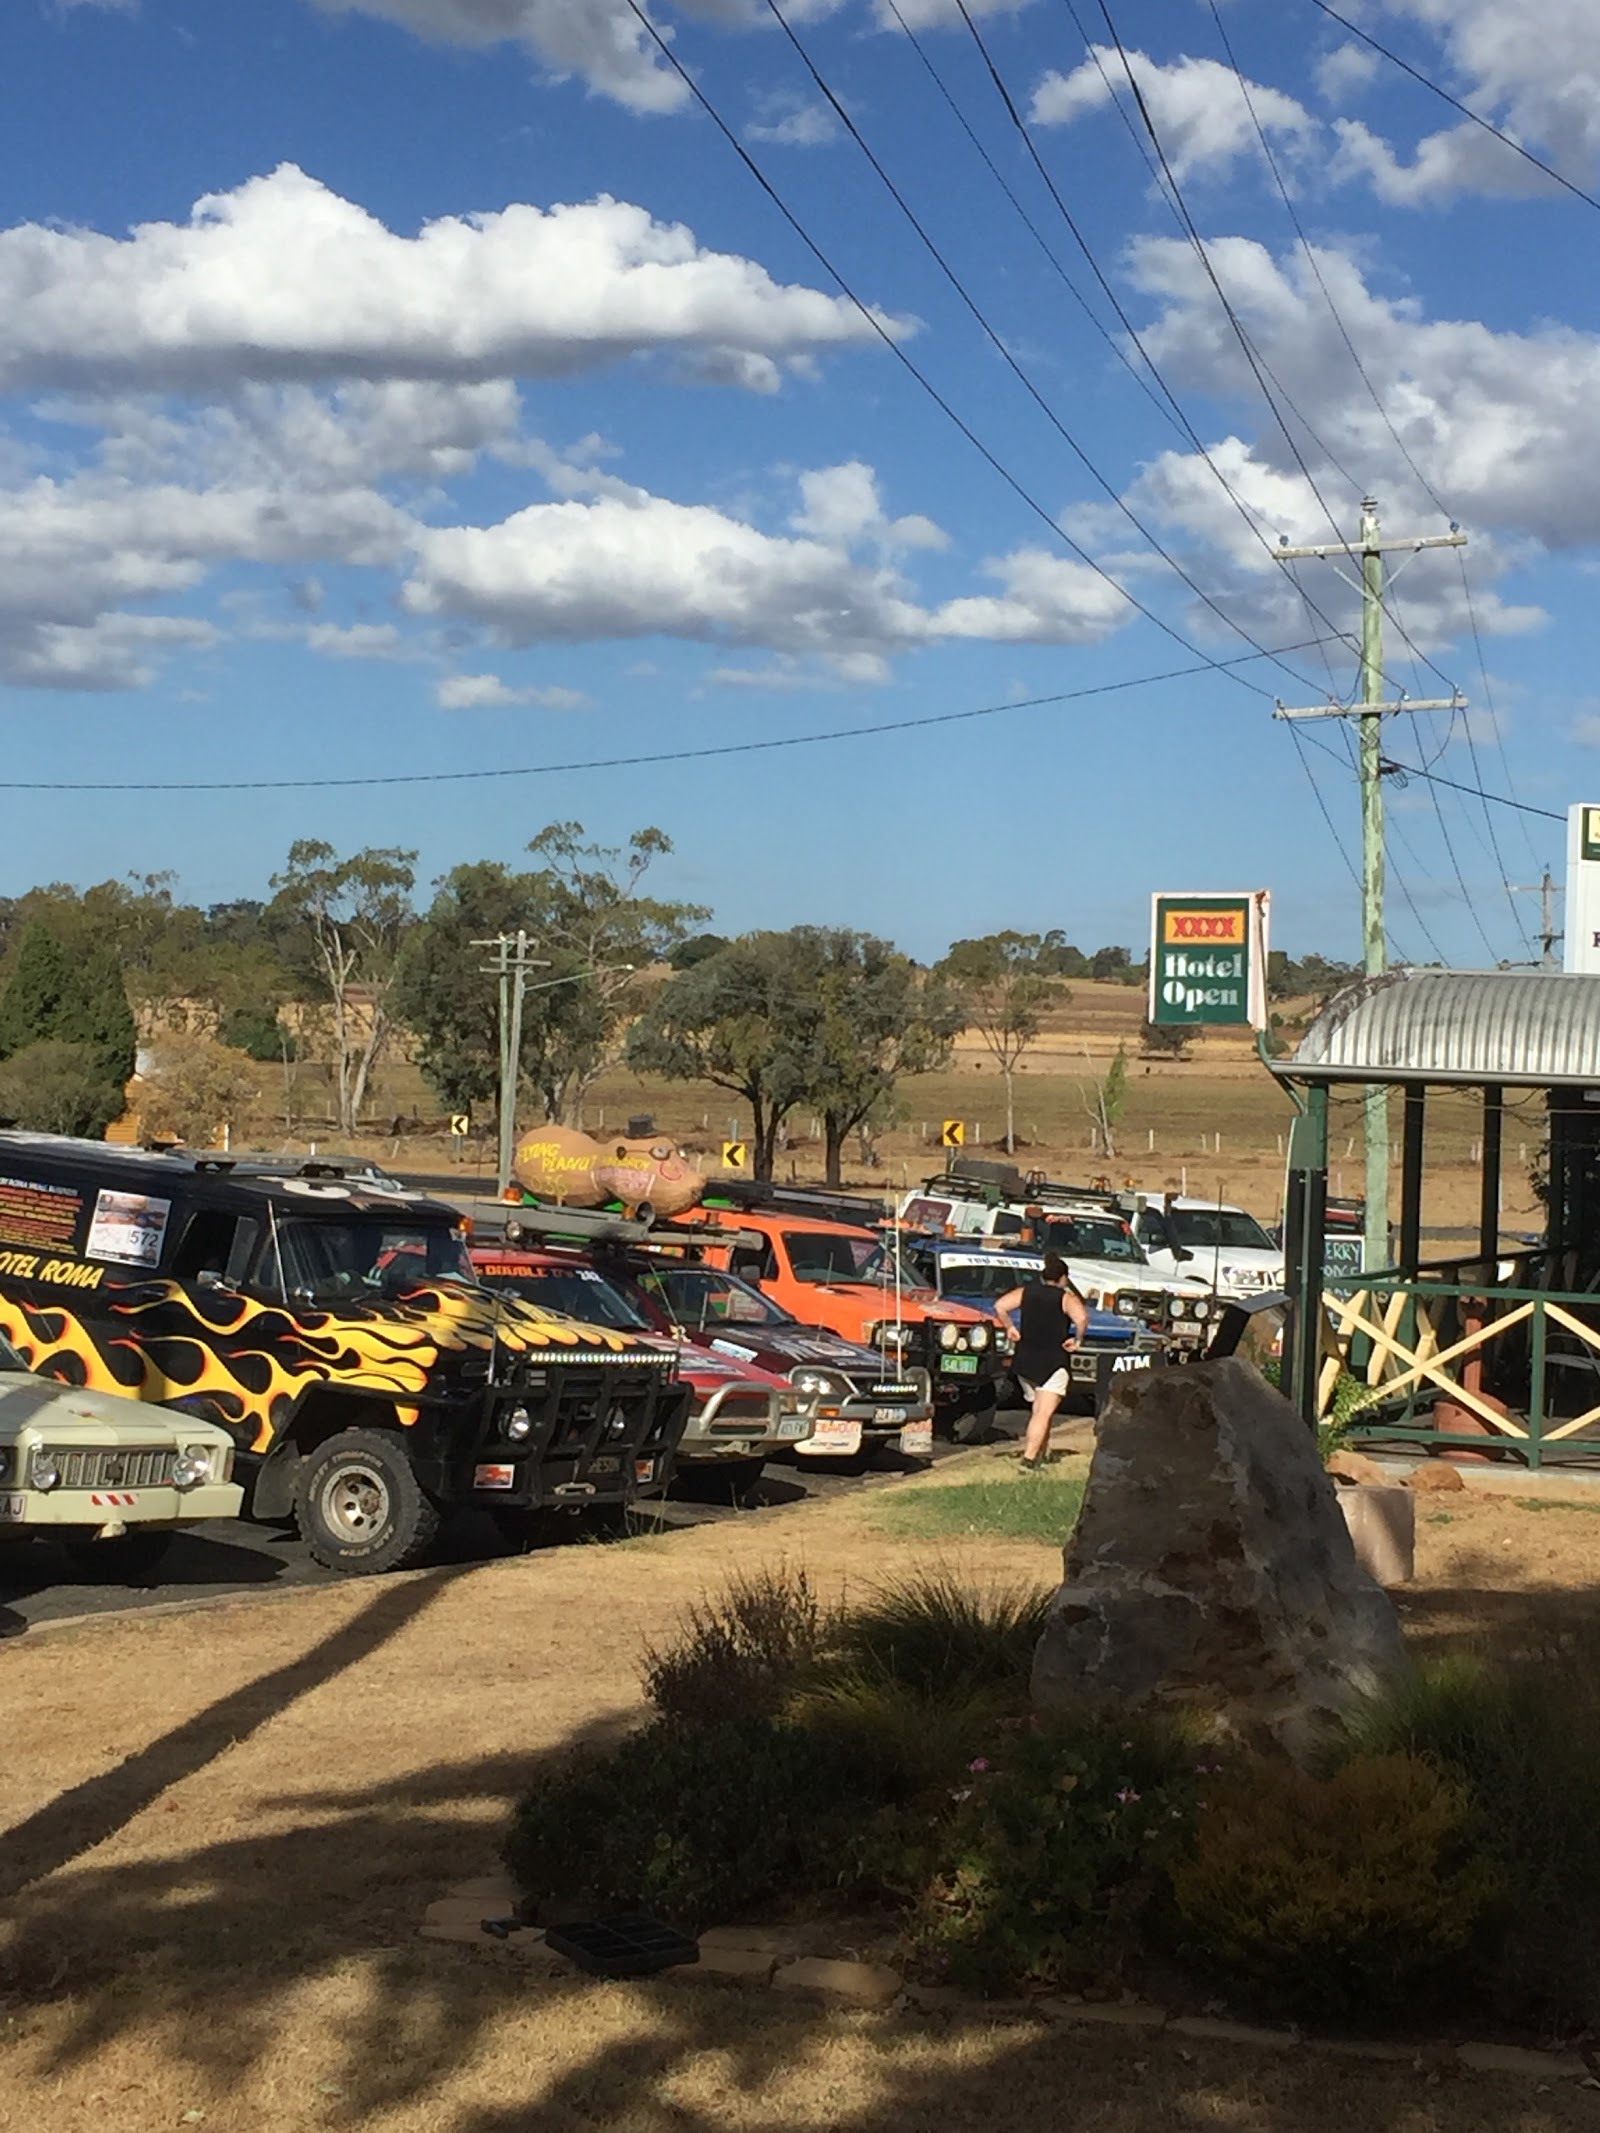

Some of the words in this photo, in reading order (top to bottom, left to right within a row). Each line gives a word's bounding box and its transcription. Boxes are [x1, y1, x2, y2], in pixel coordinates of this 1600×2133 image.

[1172, 916, 1236, 938] XXXX
[1163, 952, 1243, 978] Hotel
[1163, 980, 1239, 1012] Open
[130, 1230, 159, 1248] 572
[38, 1259, 105, 1290] ROMA
[1112, 1354, 1151, 1372] ATM
[0, 1496, 24, 1516] AJ
